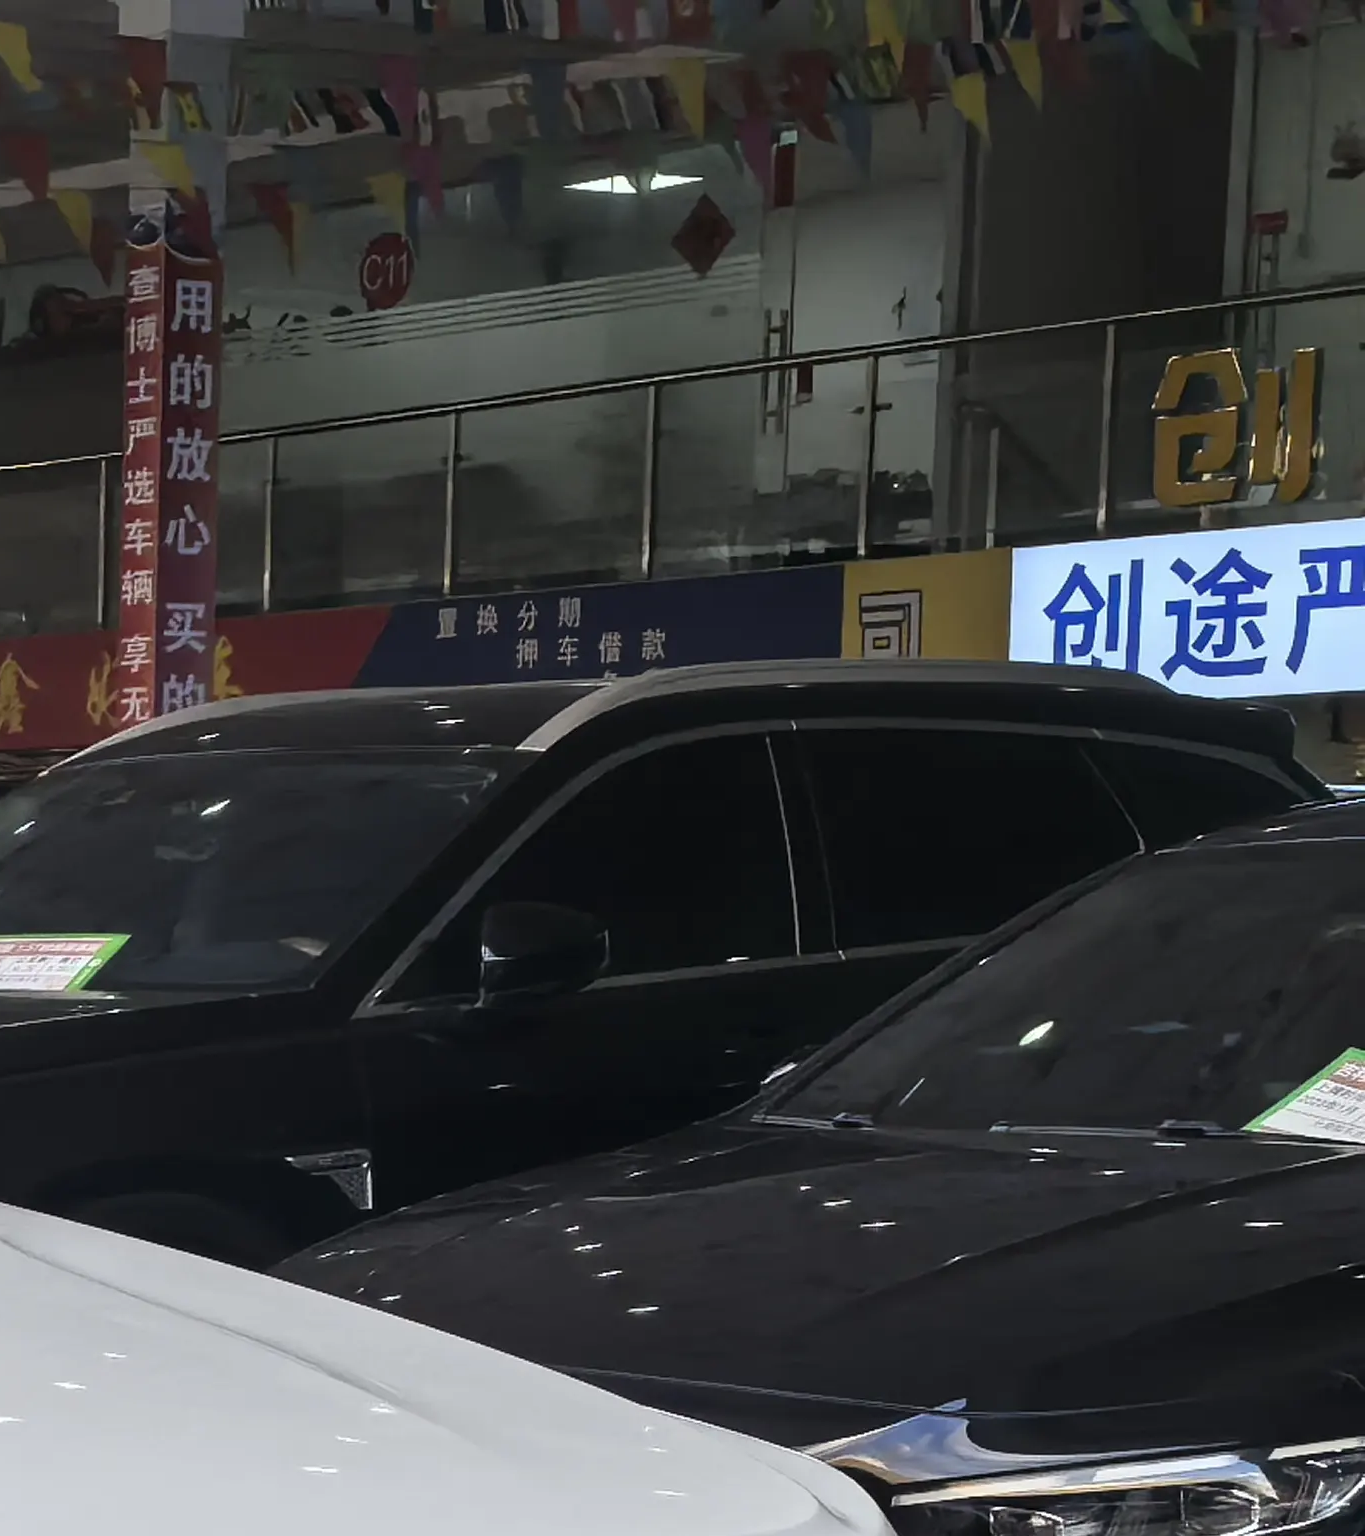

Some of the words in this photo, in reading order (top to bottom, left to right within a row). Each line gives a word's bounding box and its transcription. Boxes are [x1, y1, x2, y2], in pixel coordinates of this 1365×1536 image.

[362, 250, 409, 291] C11
[1151, 346, 1325, 508] 创
[435, 596, 582, 639] 置换分期
